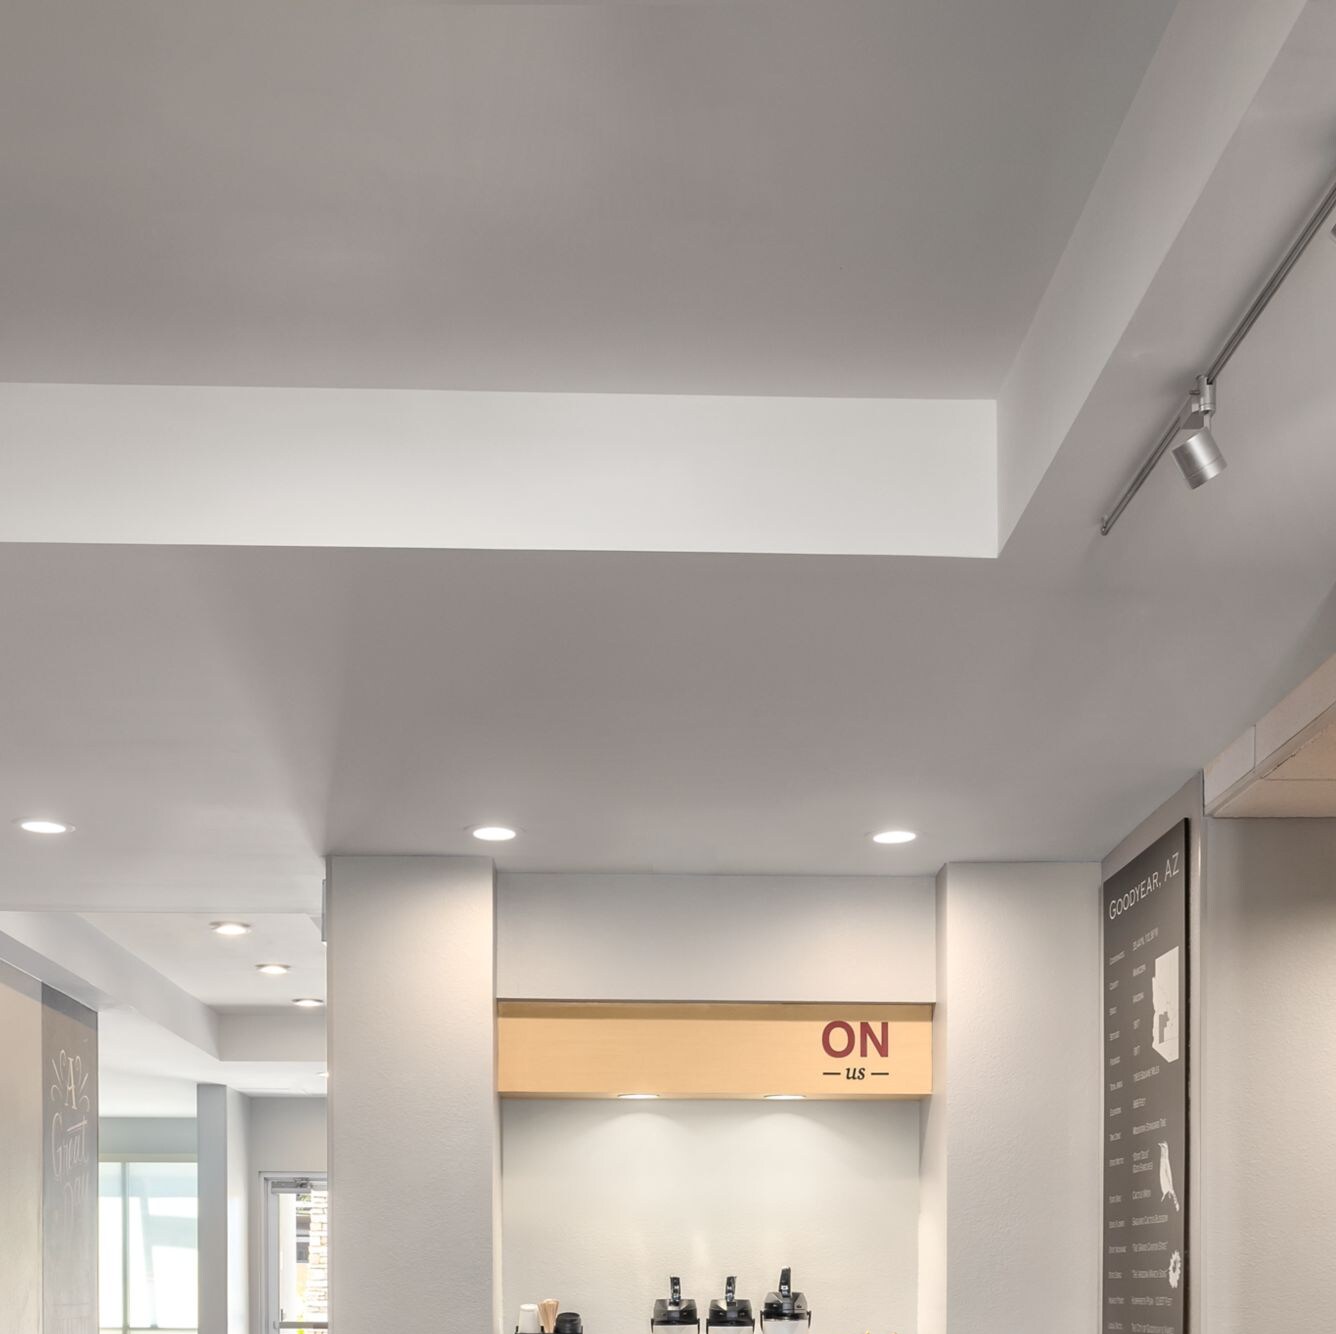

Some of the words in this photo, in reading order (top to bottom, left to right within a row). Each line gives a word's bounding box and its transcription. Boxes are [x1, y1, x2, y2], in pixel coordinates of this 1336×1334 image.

[1109, 872, 1162, 920] GOODYEAR,
[1164, 852, 1180, 882] AZ
[822, 1020, 889, 1058] ON
[845, 1067, 866, 1080] us
